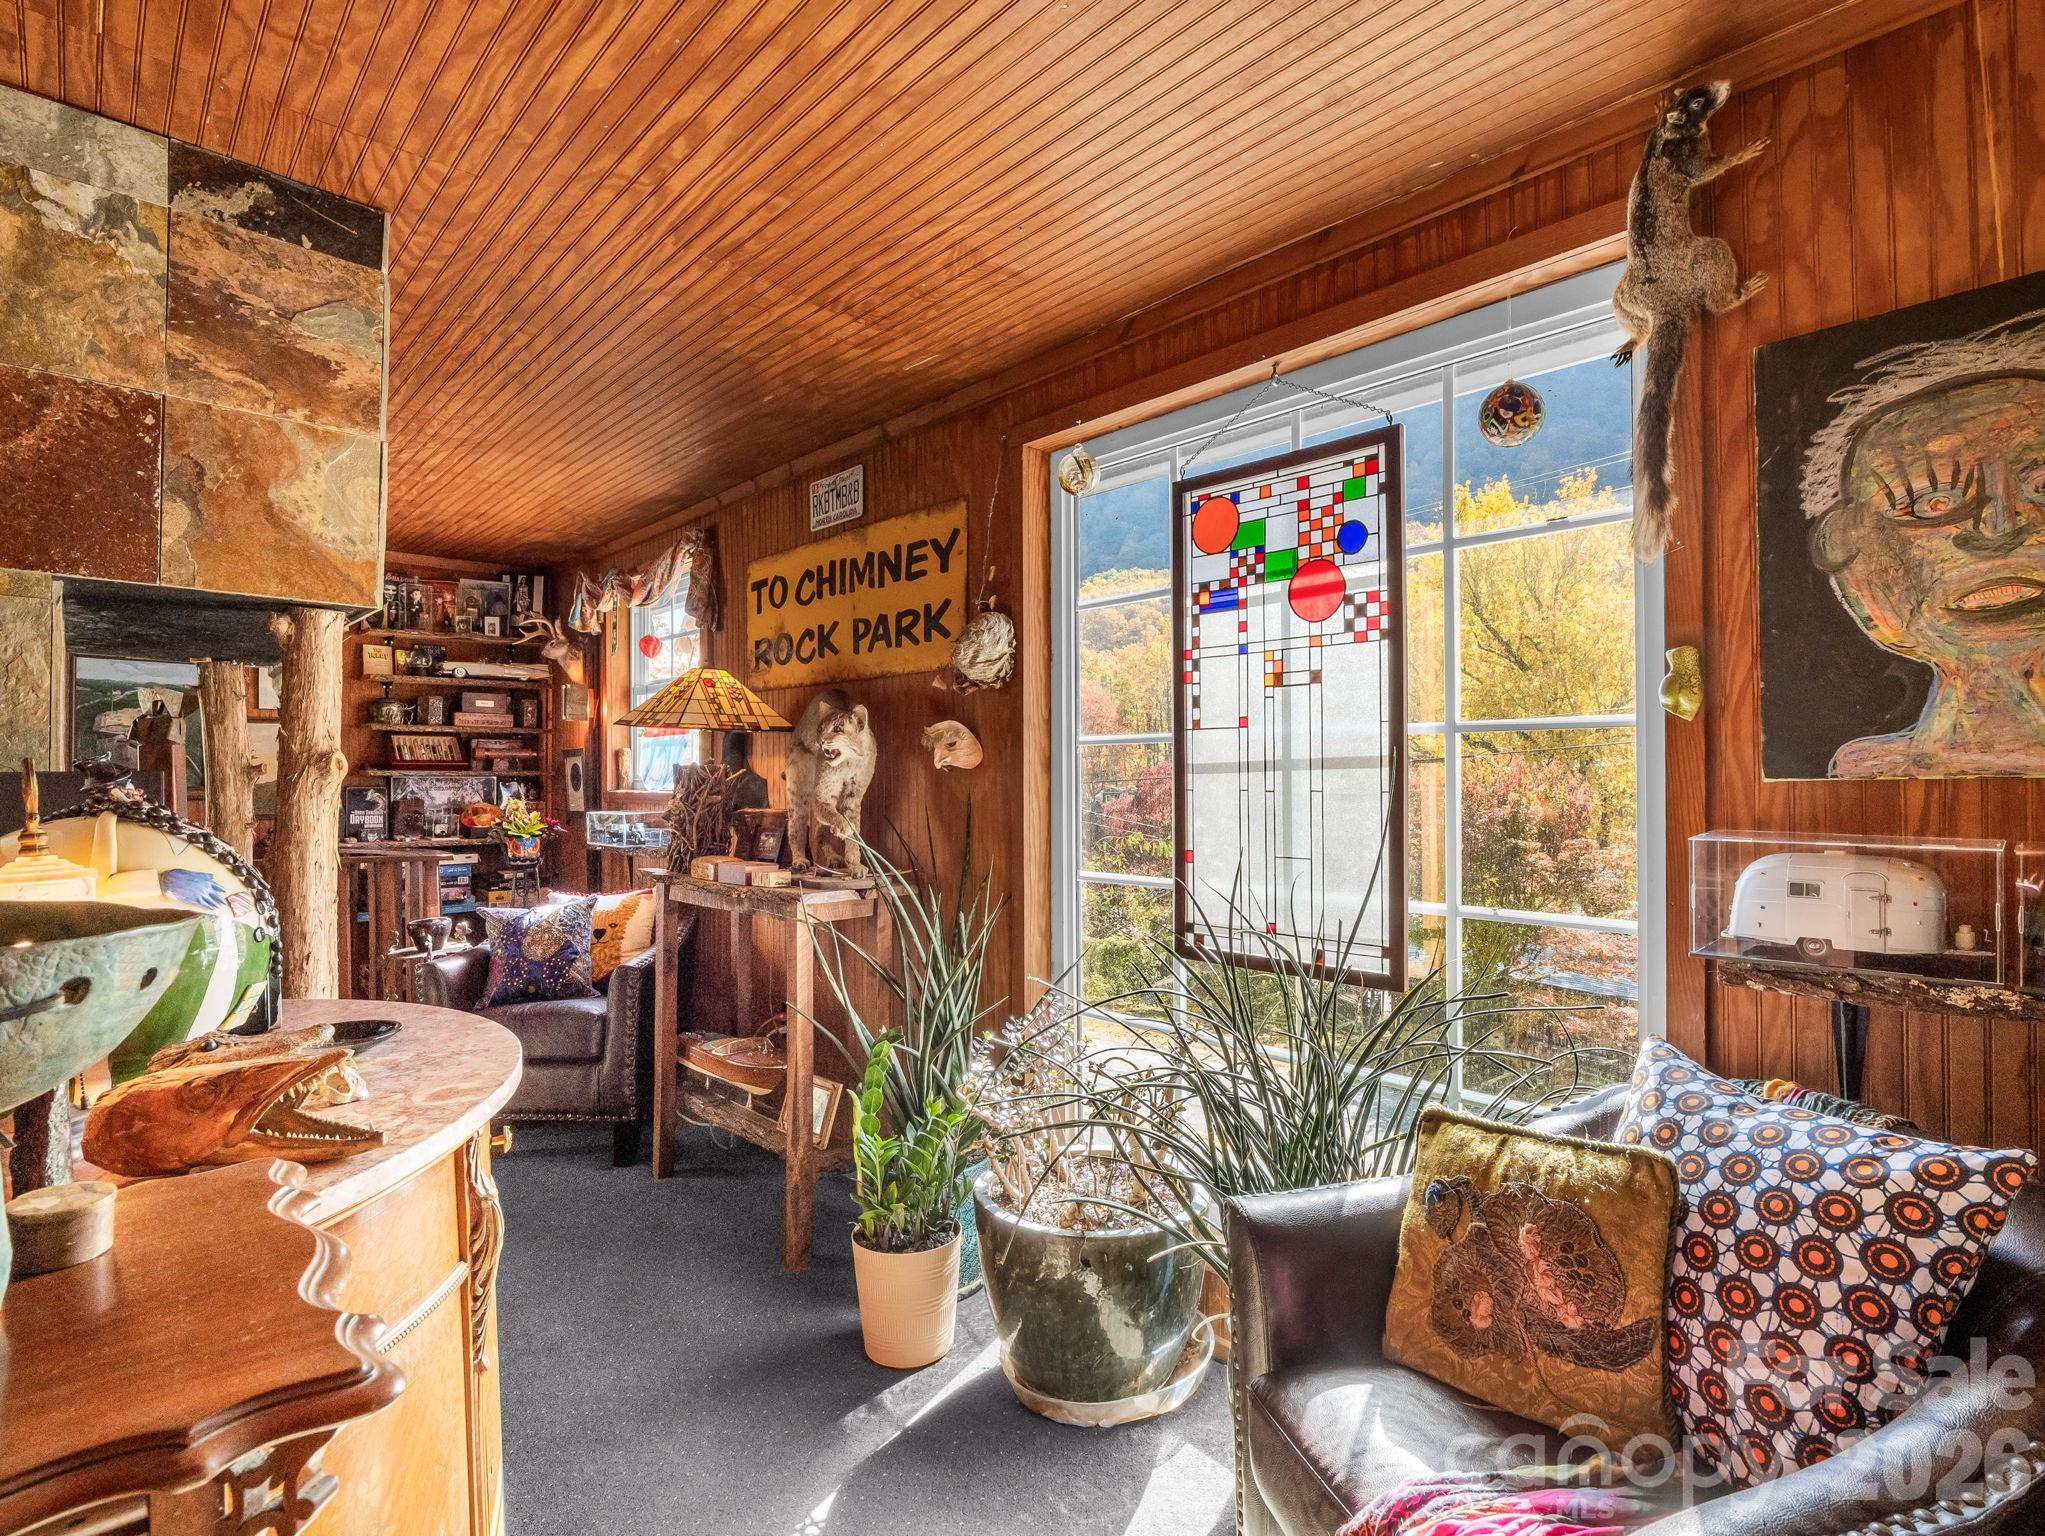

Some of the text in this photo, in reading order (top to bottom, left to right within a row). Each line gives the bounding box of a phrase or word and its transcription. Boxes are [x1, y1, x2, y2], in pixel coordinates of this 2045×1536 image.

[833, 507, 858, 521] CAROLINA
[751, 527, 961, 615] TO CHIMNEY
[754, 598, 953, 673] ROCK PARK
